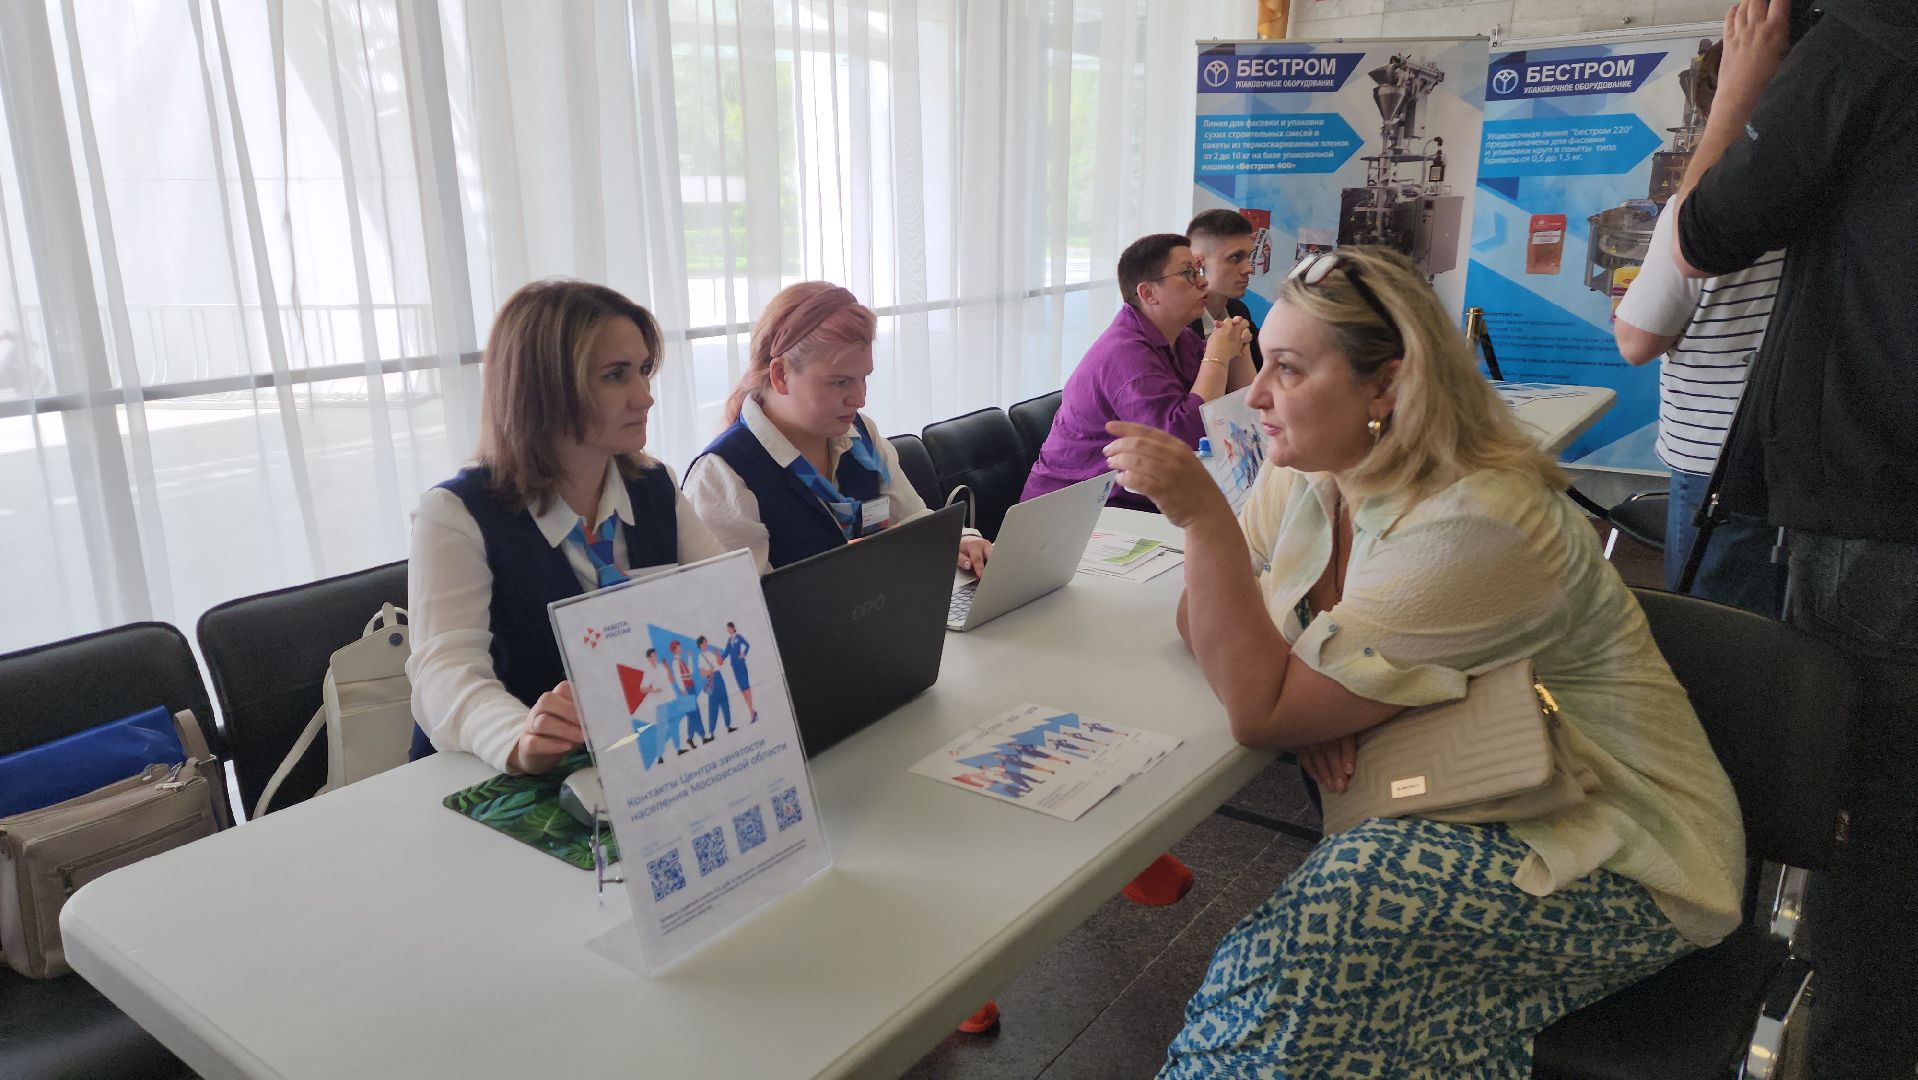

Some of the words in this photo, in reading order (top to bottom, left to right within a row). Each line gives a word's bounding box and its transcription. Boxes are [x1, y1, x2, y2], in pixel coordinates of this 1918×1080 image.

[1237, 58, 1336, 77] БЕСТРОМ
[1526, 59, 1635, 83] БЕСТРОМ
[1235, 80, 1282, 88] УПАКОВОЧНОЕ
[1283, 79, 1335, 88] ОБОРУДОВАНИЕ
[1523, 83, 1574, 94] УПАКОВОЧНОЕ
[1574, 80, 1632, 92] ОБОРУДОВАНИЕ
[1229, 120, 1244, 128] для
[1245, 119, 1280, 128] фасовки
[1287, 120, 1324, 128] упаковки
[1204, 132, 1227, 140] сухих
[1228, 131, 1284, 139] строительных
[1285, 129, 1312, 137] смесей
[1487, 131, 1541, 140] Упаковочная
[1242, 141, 1319, 150] термосвариваемых
[1485, 139, 1550, 149] предназначена
[1568, 136, 1606, 145] фасовки
[1232, 152, 1241, 160] 10
[1263, 151, 1281, 159] базе
[1283, 151, 1334, 160] упаковочной
[1531, 147, 1553, 156] круп
[1561, 145, 1592, 153] пакеты
[627, 780, 678, 809] Контакты
[679, 761, 717, 785] Центра
[720, 739, 765, 766] занятости
[631, 789, 689, 822] населения
[690, 760, 749, 794] Московской
[751, 743, 787, 765] области
